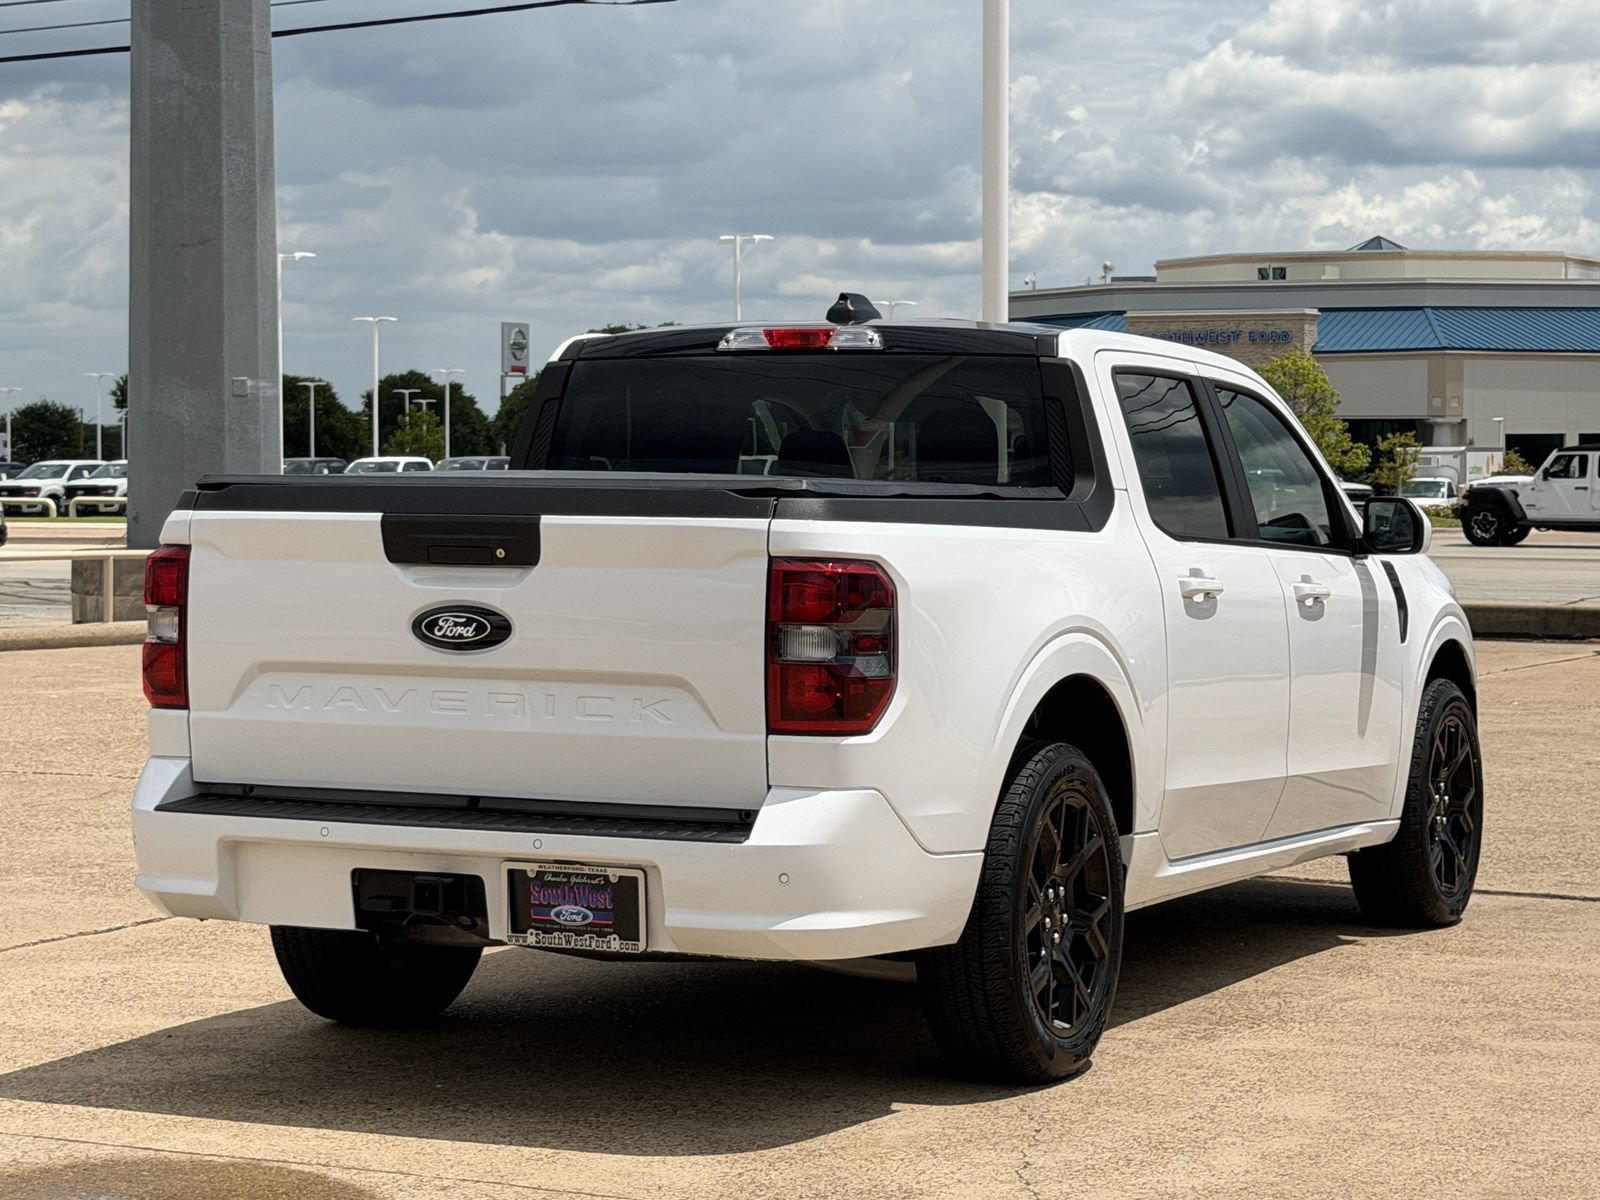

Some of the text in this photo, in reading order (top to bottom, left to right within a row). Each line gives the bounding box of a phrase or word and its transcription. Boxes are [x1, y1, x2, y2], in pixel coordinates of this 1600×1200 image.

[1248, 330, 1292, 344] FORD
[433, 616, 477, 638] Ford
[265, 683, 674, 724] MAVERICK
[559, 908, 584, 922] Ford
